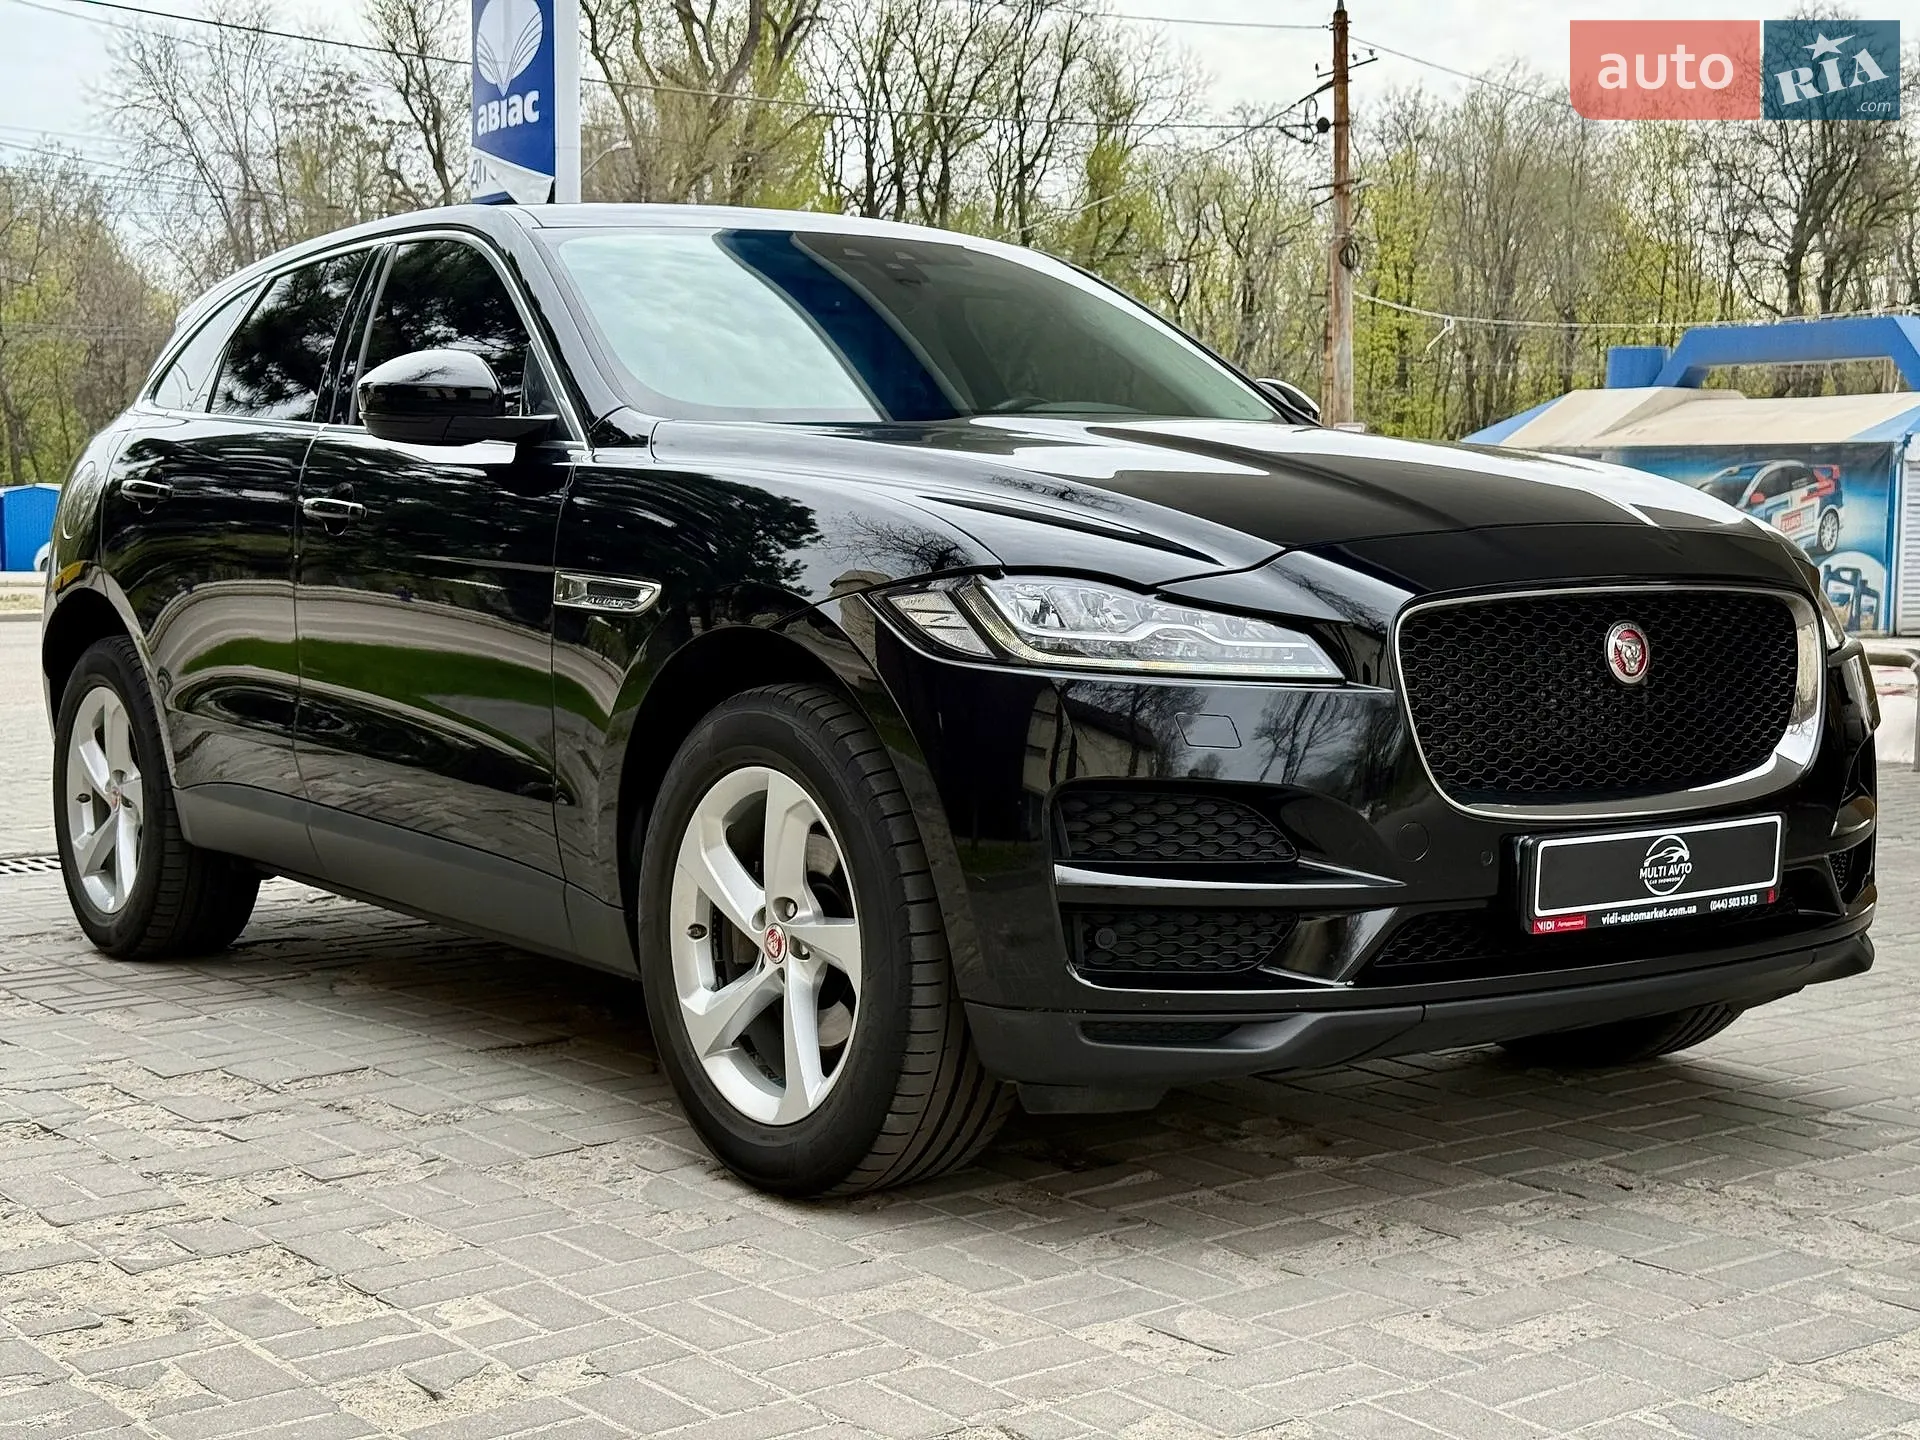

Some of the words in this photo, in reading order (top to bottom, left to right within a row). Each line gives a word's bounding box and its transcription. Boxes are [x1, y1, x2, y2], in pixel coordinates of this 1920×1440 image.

[1639, 865, 1667, 880] MULTI
[1668, 862, 1693, 876] AVTO
[1710, 898, 1728, 911] (044)
[1601, 905, 1698, 925] vidi-automarket.com.ua
[1536, 920, 1555, 932] VIDI
